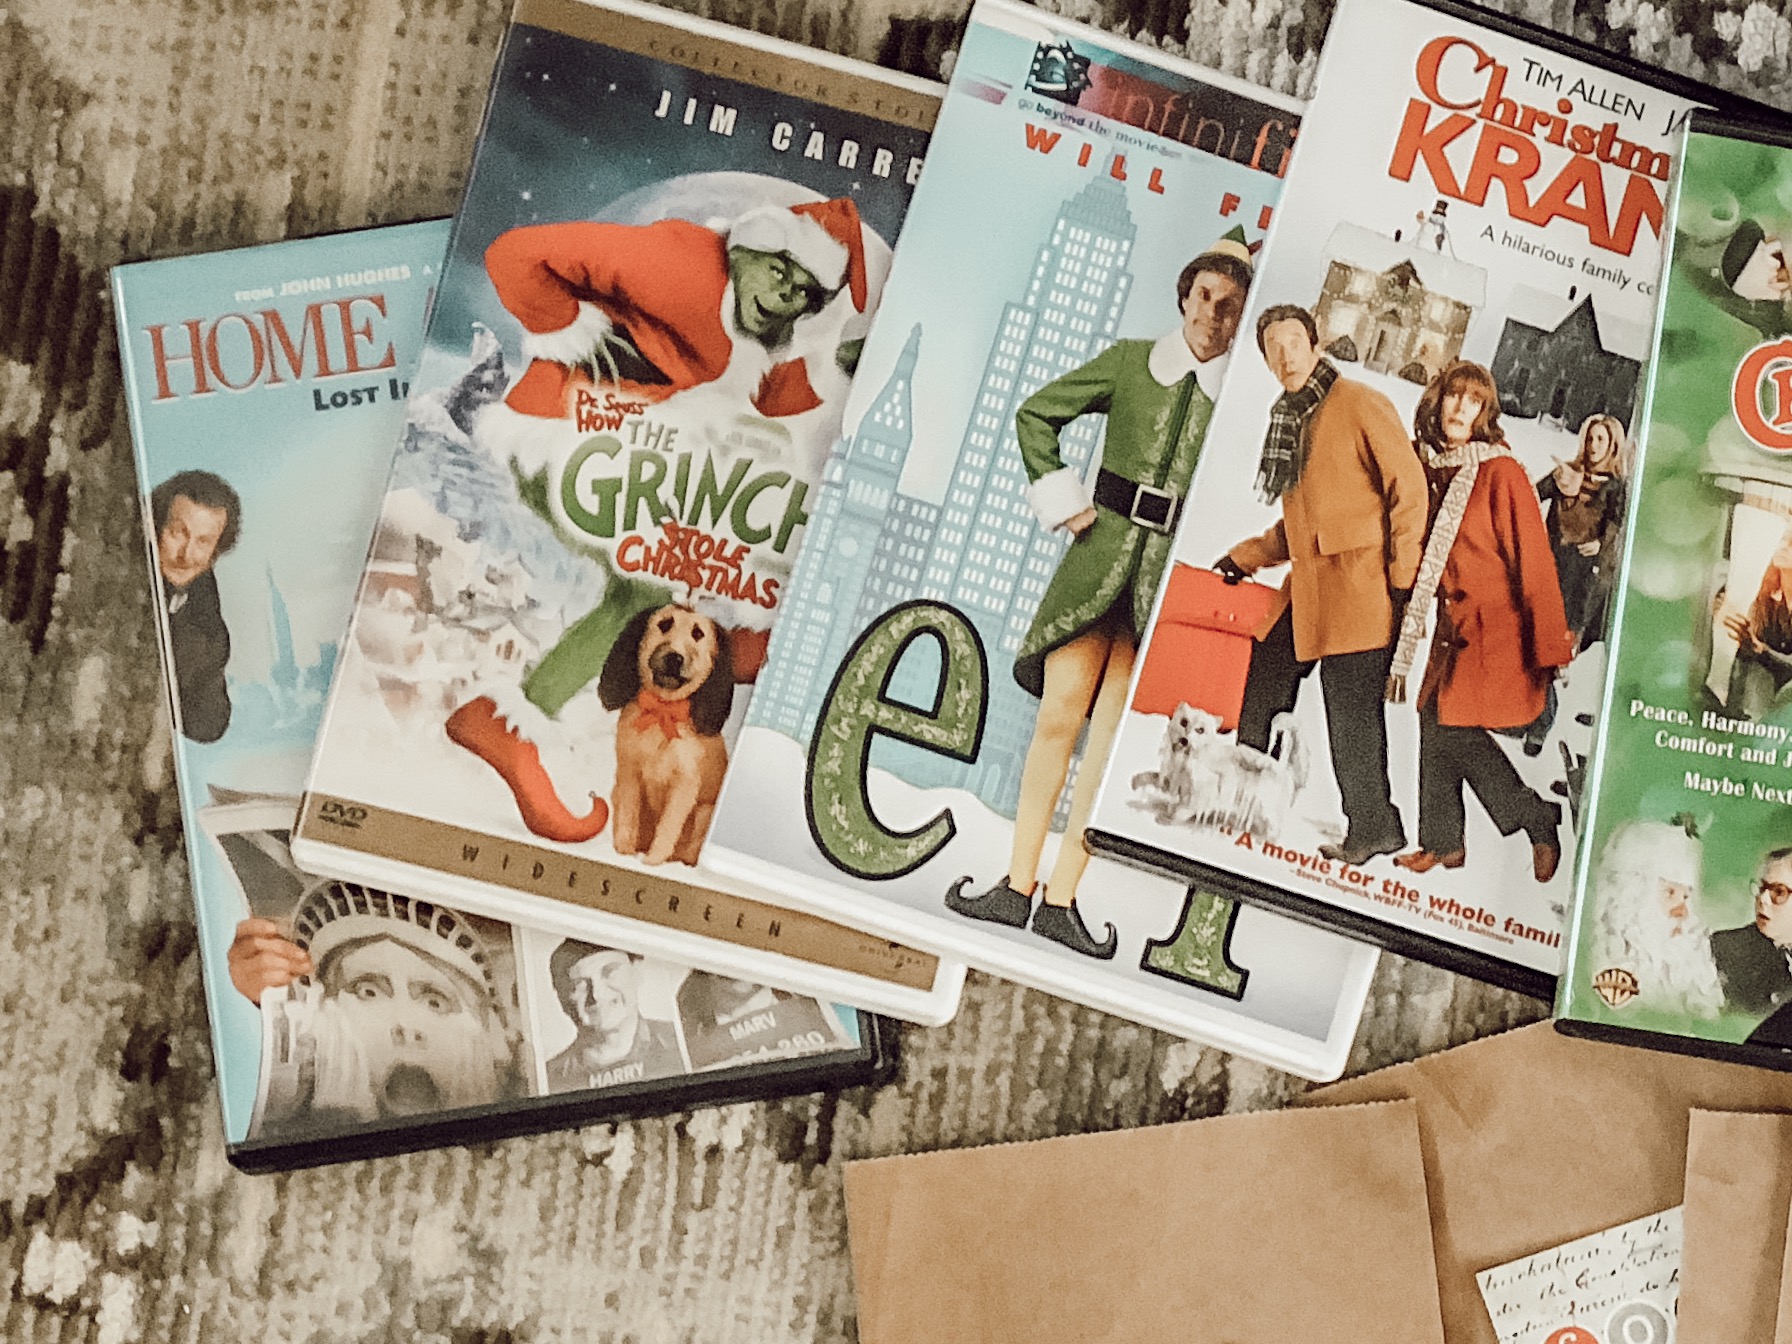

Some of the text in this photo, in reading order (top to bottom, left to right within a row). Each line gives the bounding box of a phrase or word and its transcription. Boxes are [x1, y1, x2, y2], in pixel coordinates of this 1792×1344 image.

[1415, 36, 1671, 182] Christm
[1522, 57, 1563, 92] TIM
[1568, 78, 1646, 121] ALLEN
[654, 89, 925, 186] JIM CARRE
[1036, 102, 1086, 128] beyond
[1088, 118, 1111, 138] the
[1025, 122, 1165, 195] WILL
[280, 275, 331, 297] JOHN
[336, 264, 411, 288] HUGHES
[1480, 225, 1495, 242] A
[1501, 231, 1575, 269] hilarious
[1581, 259, 1632, 290] family
[142, 294, 396, 401] HOME
[577, 406, 626, 433] HOW
[626, 419, 679, 453] THE
[616, 534, 781, 610] CHRISTMAS
[661, 520, 750, 568] STOLE
[1654, 729, 1735, 760] Comfort
[1739, 747, 1777, 766] and
[1683, 770, 1746, 797] Maybe
[461, 843, 782, 939] WIDESCREEN
[1261, 840, 1332, 874] movie
[1339, 863, 1376, 888] for
[1382, 877, 1421, 902] the
[1428, 893, 1497, 928] whole
[729, 1010, 777, 1041] MARV
[588, 1061, 646, 1089] HARRY
